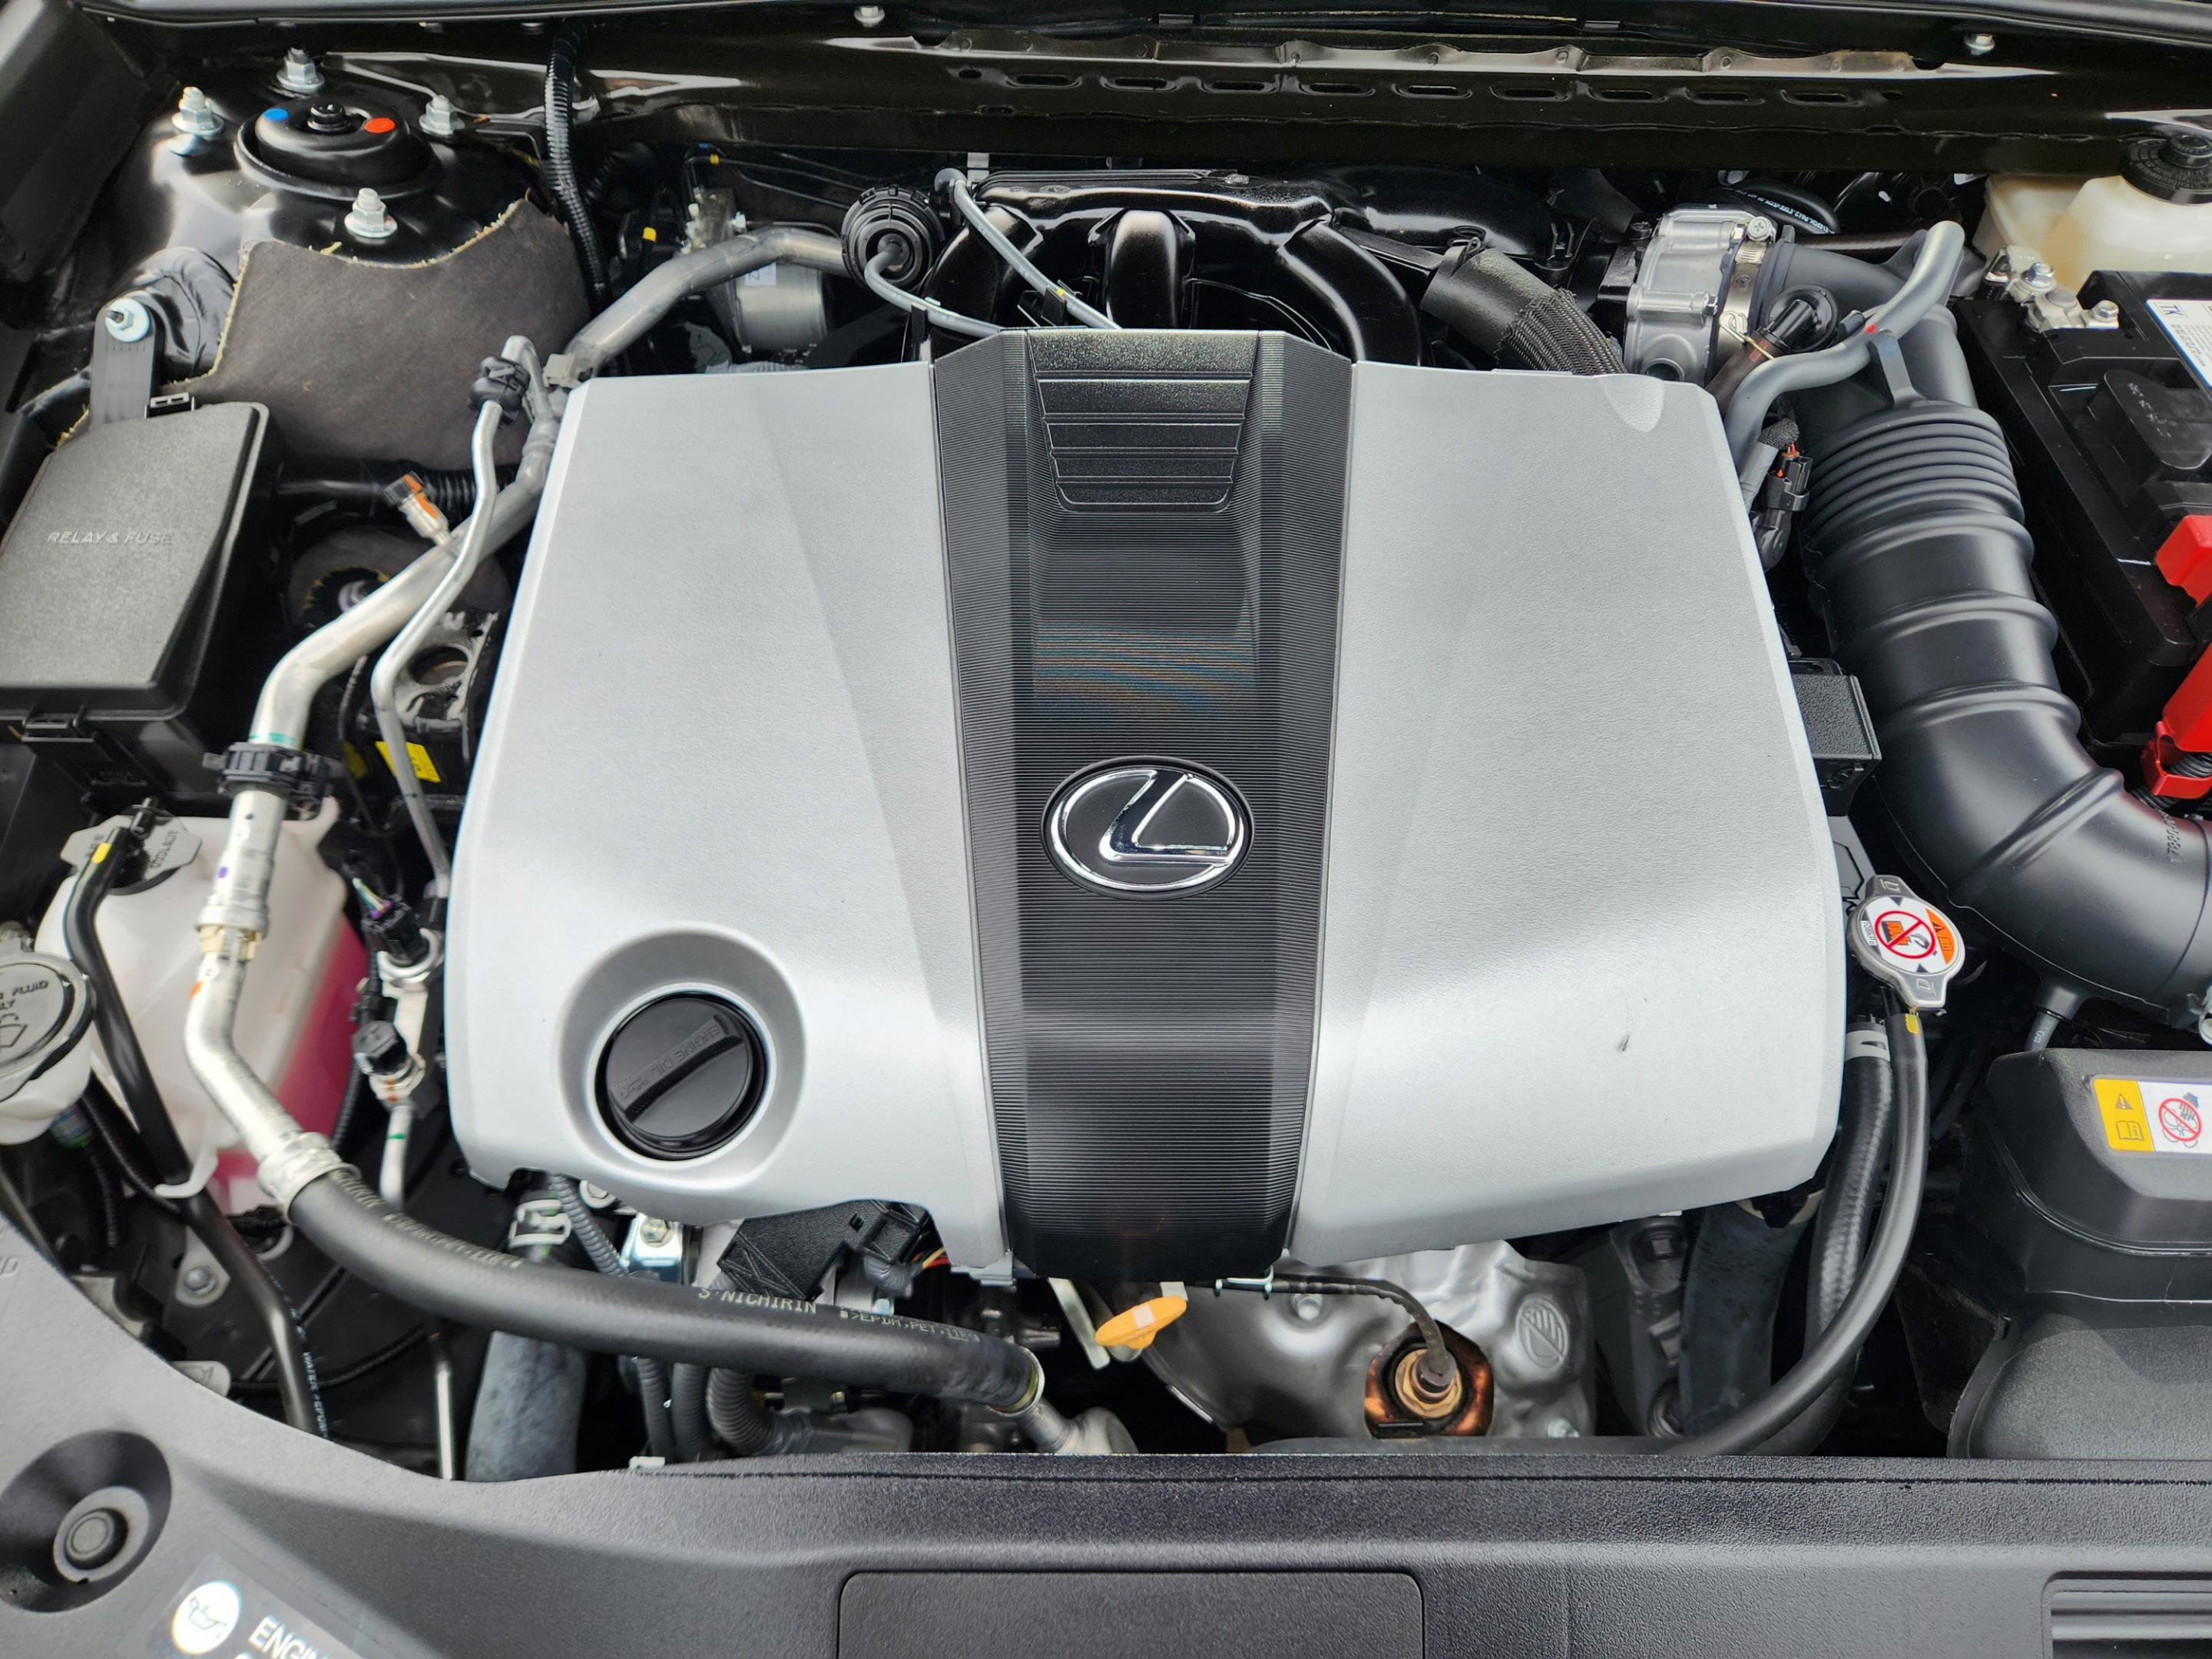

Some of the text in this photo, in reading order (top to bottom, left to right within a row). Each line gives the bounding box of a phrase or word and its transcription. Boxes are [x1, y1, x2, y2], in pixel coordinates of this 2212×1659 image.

[47, 531, 174, 545] RELAY & FUSE
[12, 980, 48, 995] FLUID
[651, 1025, 720, 1075] ENGINE OIL
